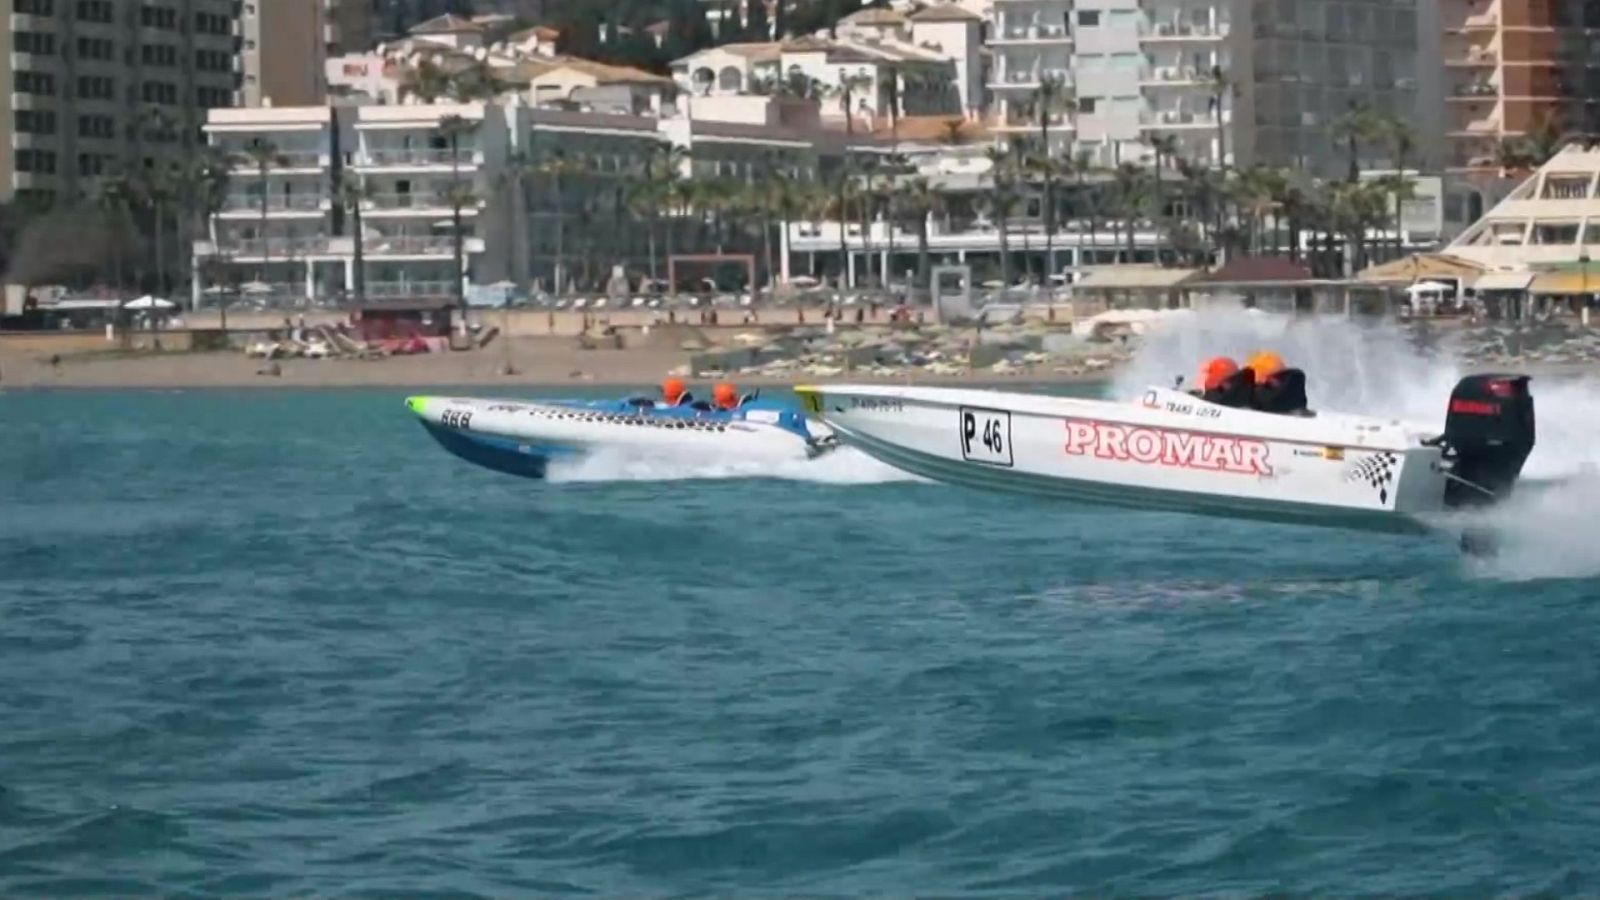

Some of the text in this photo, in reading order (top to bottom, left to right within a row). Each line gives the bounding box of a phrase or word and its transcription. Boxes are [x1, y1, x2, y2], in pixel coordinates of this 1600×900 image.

[964, 412, 1002, 454] P 46
[1065, 419, 1274, 476] PROMAR
